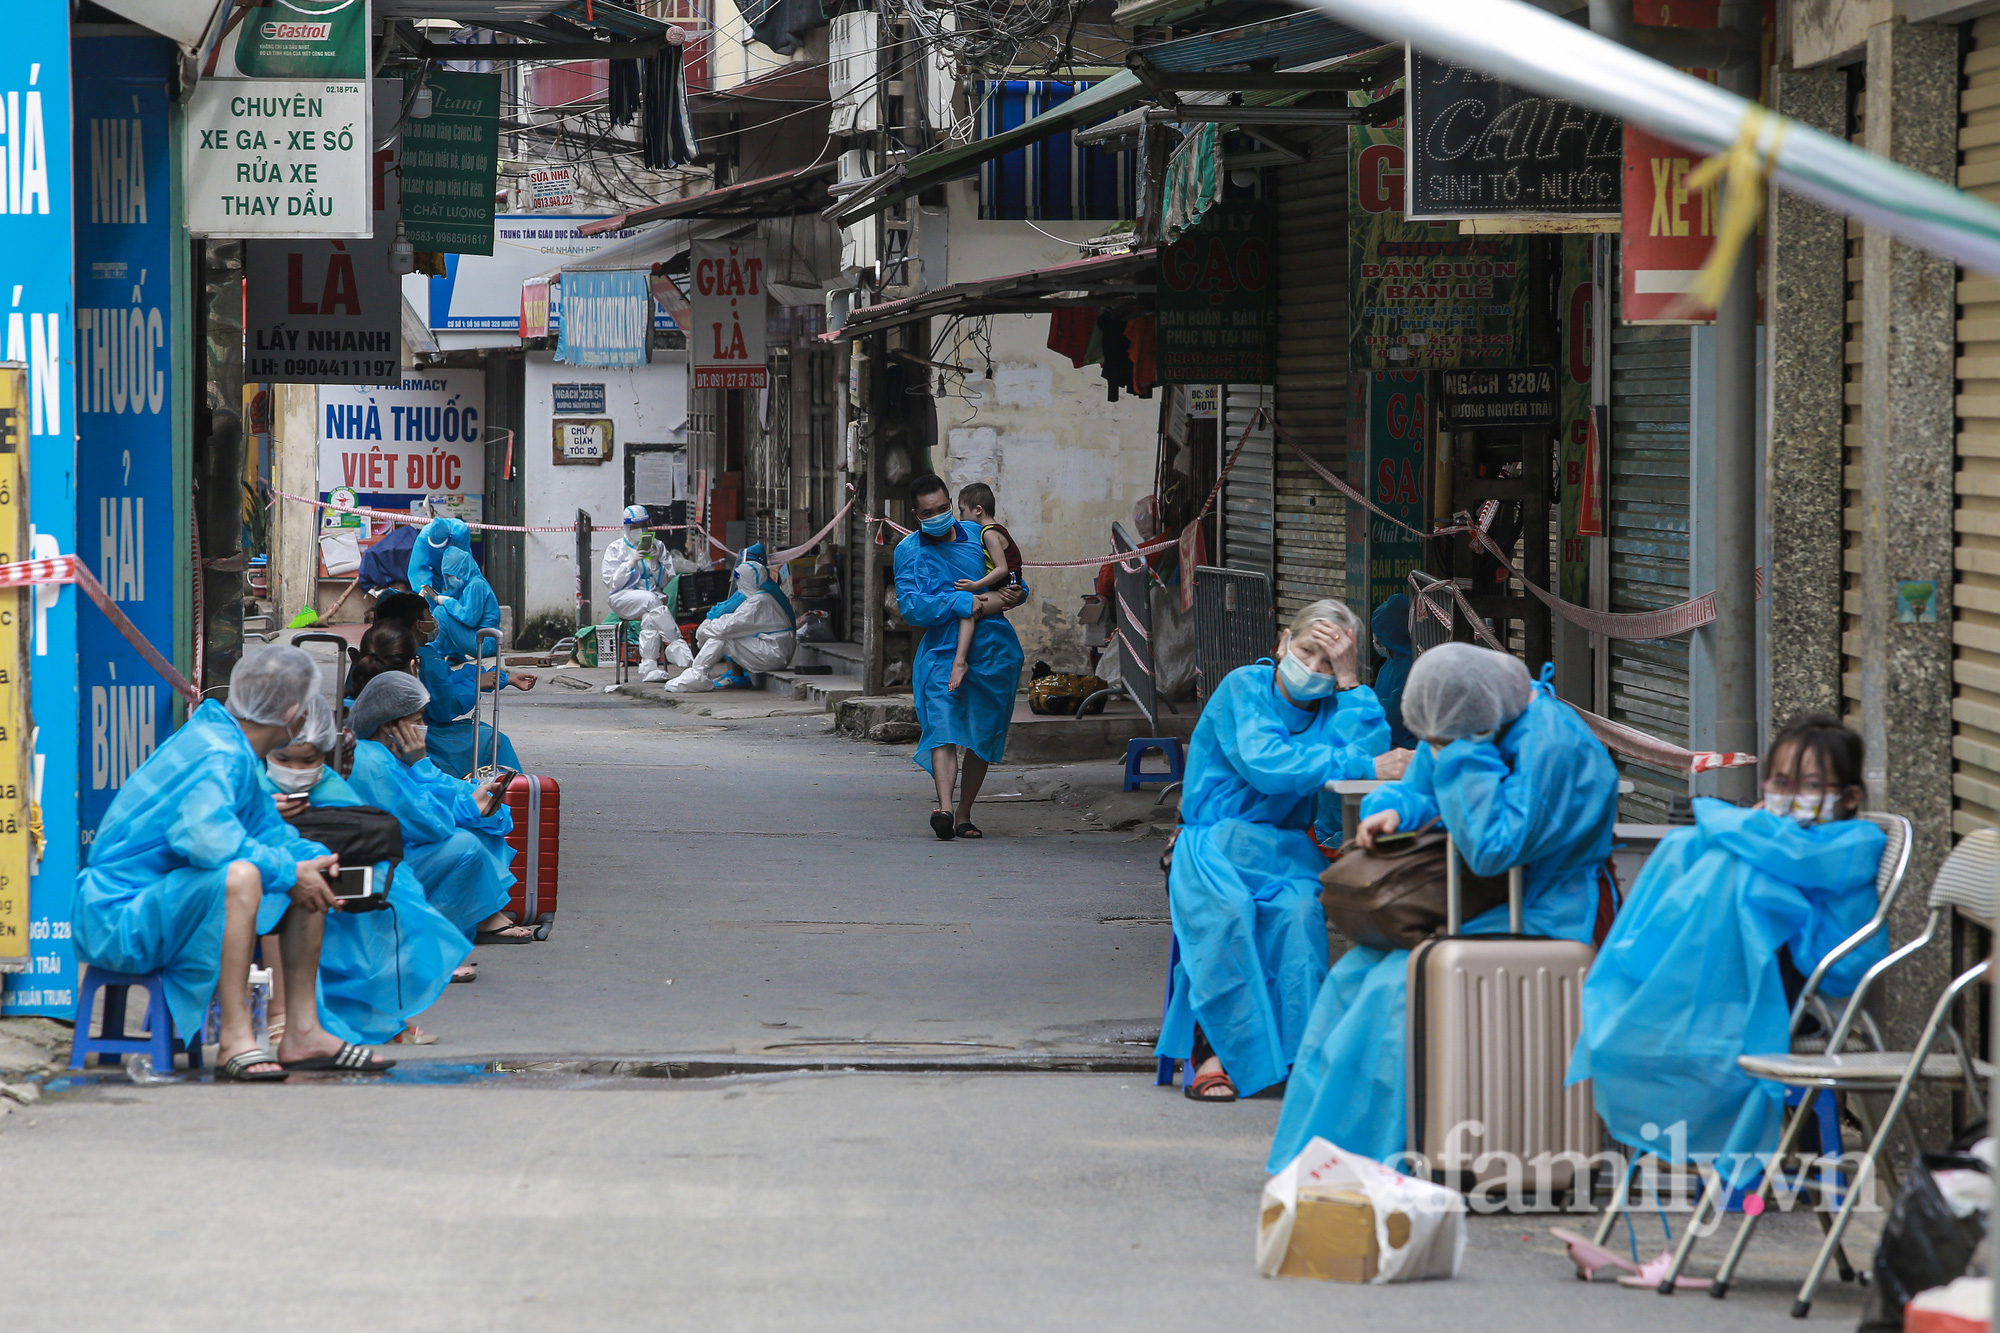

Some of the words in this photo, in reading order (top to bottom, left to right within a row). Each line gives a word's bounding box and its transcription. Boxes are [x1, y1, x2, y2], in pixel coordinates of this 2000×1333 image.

[277, 24, 327, 38] Castrol
[231, 93, 322, 118] CHUYÊN
[0, 63, 50, 214] IÁ
[200, 130, 228, 149] XE
[236, 130, 267, 150] GA
[288, 130, 315, 149] XE
[323, 123, 354, 151] SỐ
[91, 95, 147, 223] NHÀ
[237, 156, 283, 183] RỬA
[290, 164, 317, 183] XE
[531, 169, 549, 182] SỬA
[551, 168, 569, 180] NHÀ
[1429, 174, 1482, 201] SINH
[1488, 166, 1520, 200] TỐ
[1541, 165, 1613, 200] NƯỚC
[222, 196, 279, 215] THAY
[287, 189, 333, 216] DẦU
[533, 195, 573, 208] 0913.948.222
[1649, 158, 1689, 236] XE
[413, 202, 444, 217] CHẤT
[446, 207, 487, 221] LƯỢNG
[1227, 210, 1253, 231] LÝ
[436, 232, 487, 245] 0968501617
[500, 229, 521, 239] TRUNG
[522, 228, 536, 239] TÂM
[538, 228, 552, 239] GIÁO
[555, 229, 568, 240] DỤC
[541, 246, 555, 254] CHI
[556, 244, 583, 254] NHÁNH
[1377, 238, 1499, 257] CHUYÊN
[287, 240, 361, 315] LÀ
[696, 247, 762, 307] GIẶT
[1161, 237, 1272, 305] GẠO
[1361, 261, 1424, 278] BÁN
[1433, 261, 1517, 278] BUÔN
[1386, 282, 1449, 300] BÁN
[1457, 278, 1494, 299] LẺ
[1160, 308, 1185, 326] BÁN
[1188, 308, 1220, 326] BUÔN
[1232, 308, 1257, 326] BÁN
[1365, 306, 1409, 319] PHỤC
[1413, 306, 1436, 319] VỤ
[1441, 304, 1474, 319] TẬN
[1479, 304, 1513, 316] NHÀ
[1450, 318, 1477, 328] PHÍ
[78, 269, 164, 415] THUỐC
[257, 323, 299, 351] LẤY
[308, 331, 391, 352] NHANH
[713, 311, 748, 359] LÀ
[1166, 329, 1198, 348] PHỤC
[1201, 330, 1217, 348] VỤ
[1219, 329, 1239, 348] TẠI
[1365, 335, 1393, 345] ĐT:
[251, 358, 279, 375] LH:
[285, 357, 396, 376] 0904411197
[711, 373, 724, 387] 091
[727, 373, 737, 387] 27
[738, 373, 748, 387] 57
[750, 373, 765, 387] 336
[1445, 370, 1499, 395] NGÁCH
[1507, 372, 1551, 394] 328/4
[555, 387, 578, 399] NGÁCH
[326, 397, 382, 440] NHÀ
[391, 394, 478, 443] THUỐC
[1451, 400, 1485, 418] ĐƯỜNG
[1487, 399, 1527, 417] NGUYỄN
[588, 446, 598, 456] ĐỘ
[341, 445, 398, 494] VIỆT
[406, 447, 461, 490] ĐỨC
[1378, 458, 1424, 518] SẠ
[100, 450, 144, 601] HẢI
[1372, 554, 1391, 579] BÁN
[92, 662, 155, 790] BÌNH
[52, 922, 72, 939] 328
[44, 989, 72, 1006] TRUNG
